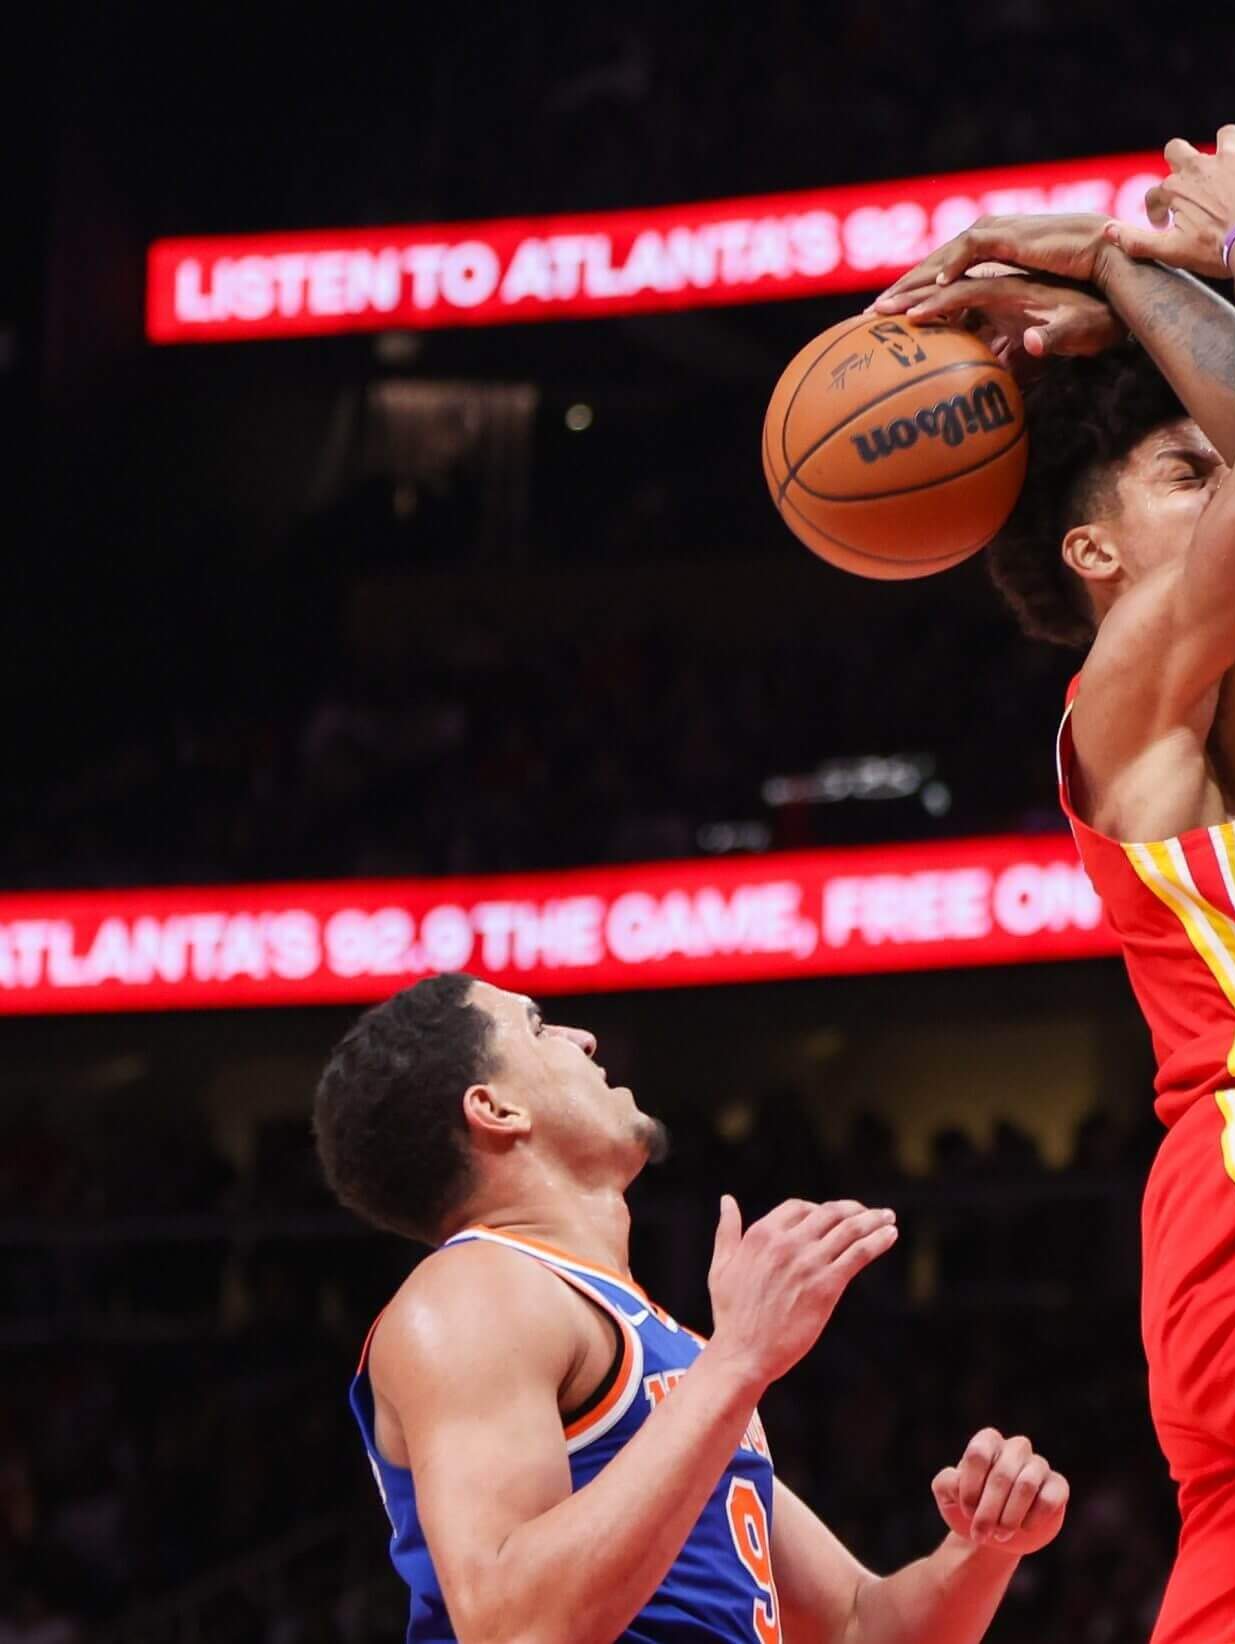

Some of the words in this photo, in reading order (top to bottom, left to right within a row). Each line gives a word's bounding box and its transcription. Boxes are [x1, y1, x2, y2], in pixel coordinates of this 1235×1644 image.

[175, 249, 400, 321] LISTEN
[402, 241, 498, 309] TO
[502, 212, 841, 302] ATLANTA'S
[852, 380, 1014, 464] Wilson
[325, 906, 473, 976] 92.9
[472, 898, 601, 969] THE
[606, 883, 818, 962] GAME,
[822, 868, 992, 946] FREE
[726, 1477, 783, 1644] 9
